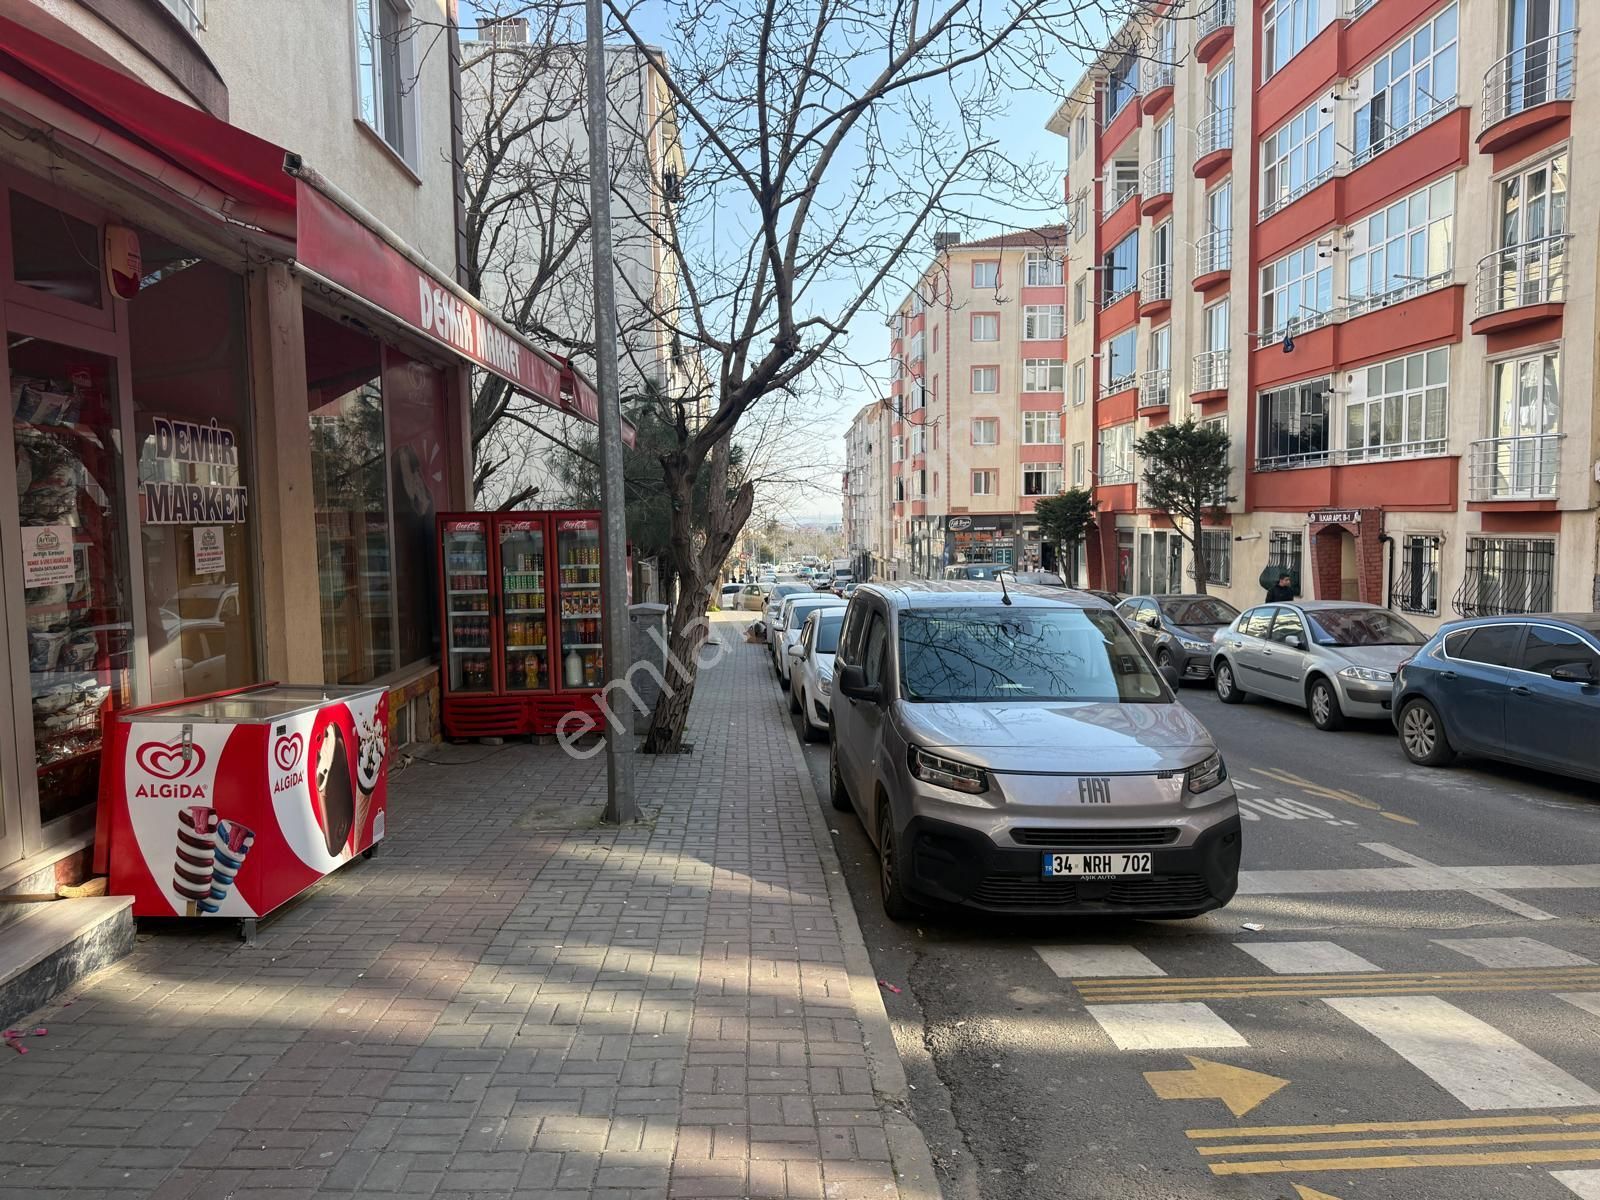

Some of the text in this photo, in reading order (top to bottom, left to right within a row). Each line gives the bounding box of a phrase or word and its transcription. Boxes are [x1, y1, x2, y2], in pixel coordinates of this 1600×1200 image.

[144, 480, 248, 524] MARKET
[1078, 778, 1111, 803] FIAT
[1054, 856, 1073, 873] 34
[1083, 855, 1112, 873] NRH
[1122, 855, 1150, 873] 702
